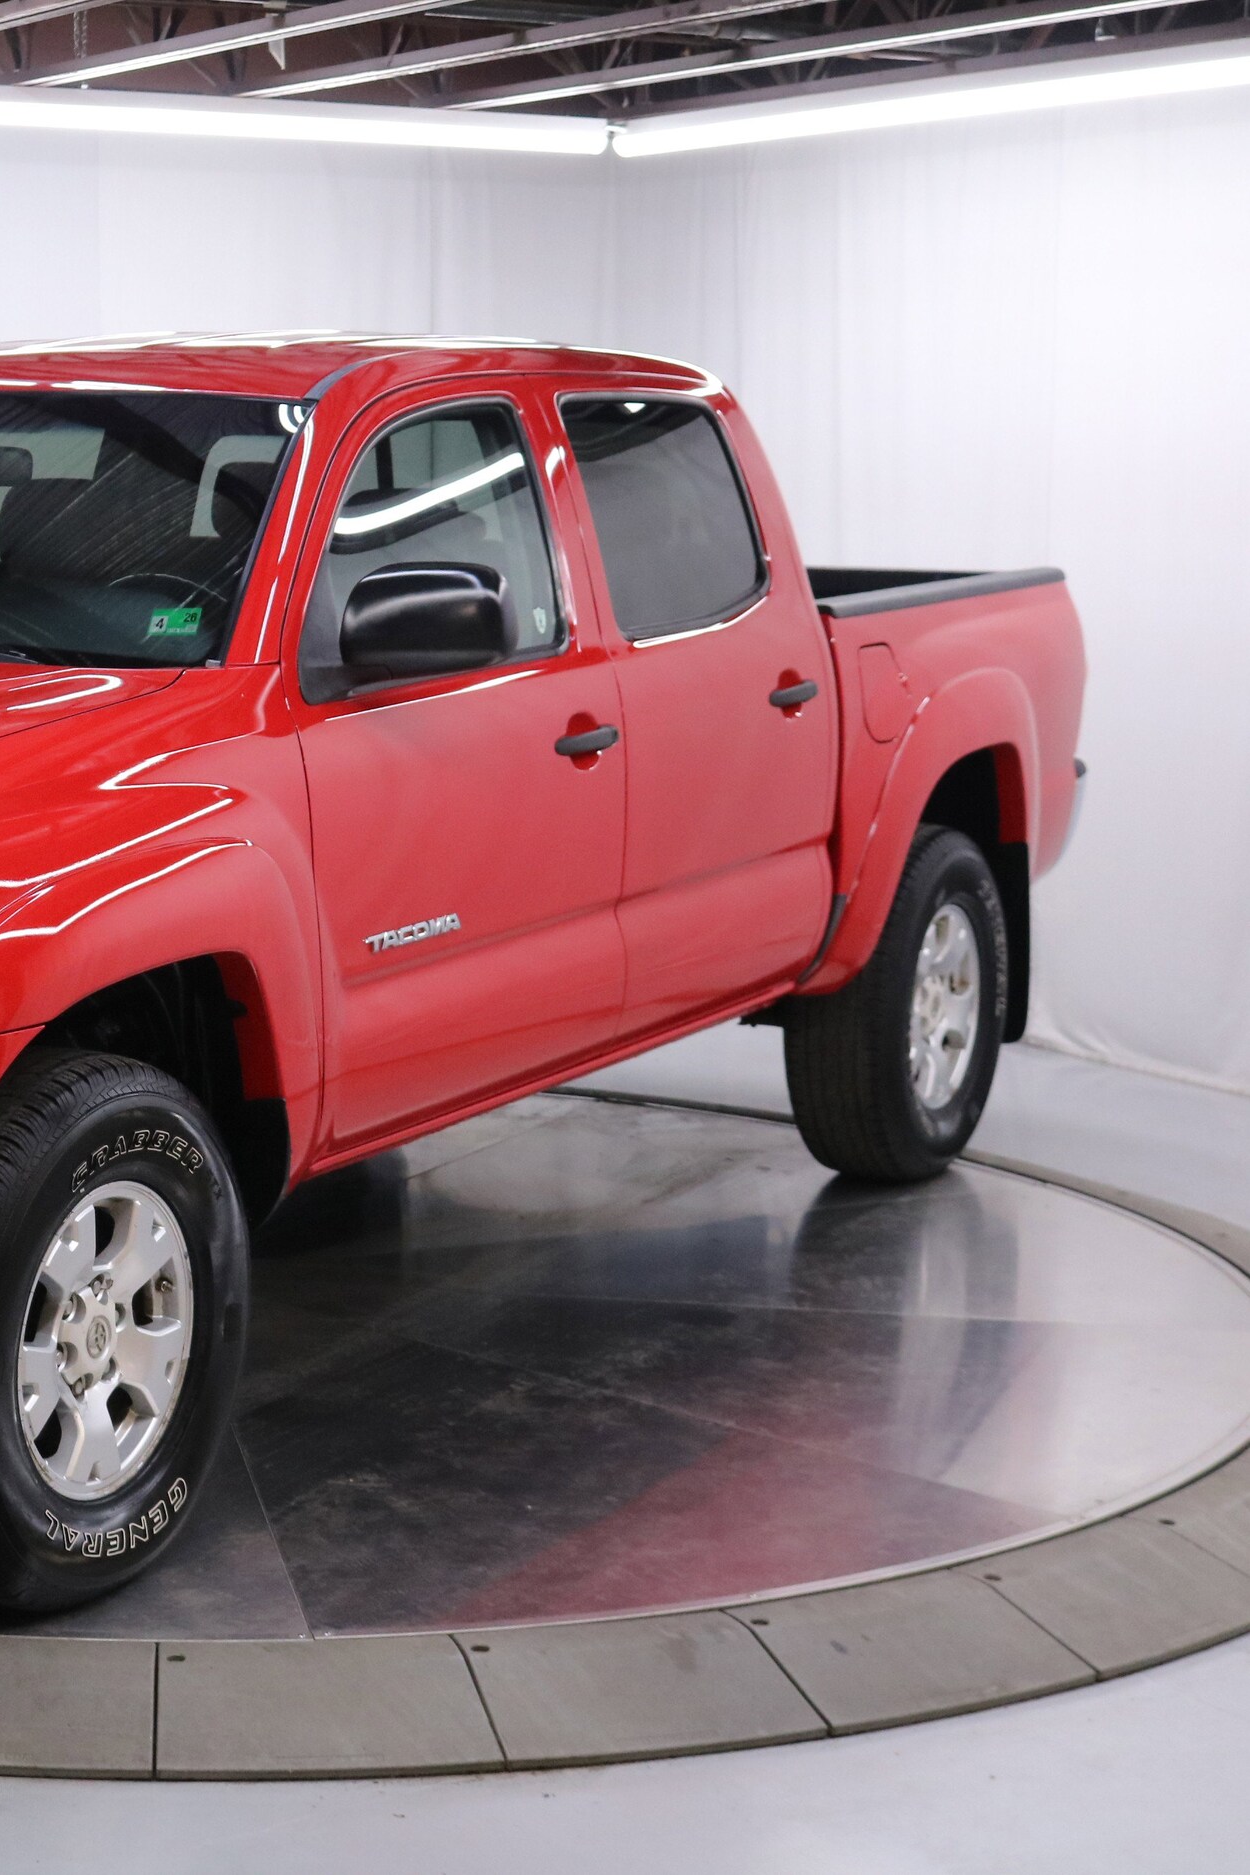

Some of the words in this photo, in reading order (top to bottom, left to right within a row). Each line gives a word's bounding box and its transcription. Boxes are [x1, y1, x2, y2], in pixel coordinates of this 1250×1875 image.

[155, 617, 165, 630] 4
[365, 913, 461, 953] TACOMA
[70, 1129, 205, 1194] GRABBER
[44, 1477, 188, 1558] GENERAL
